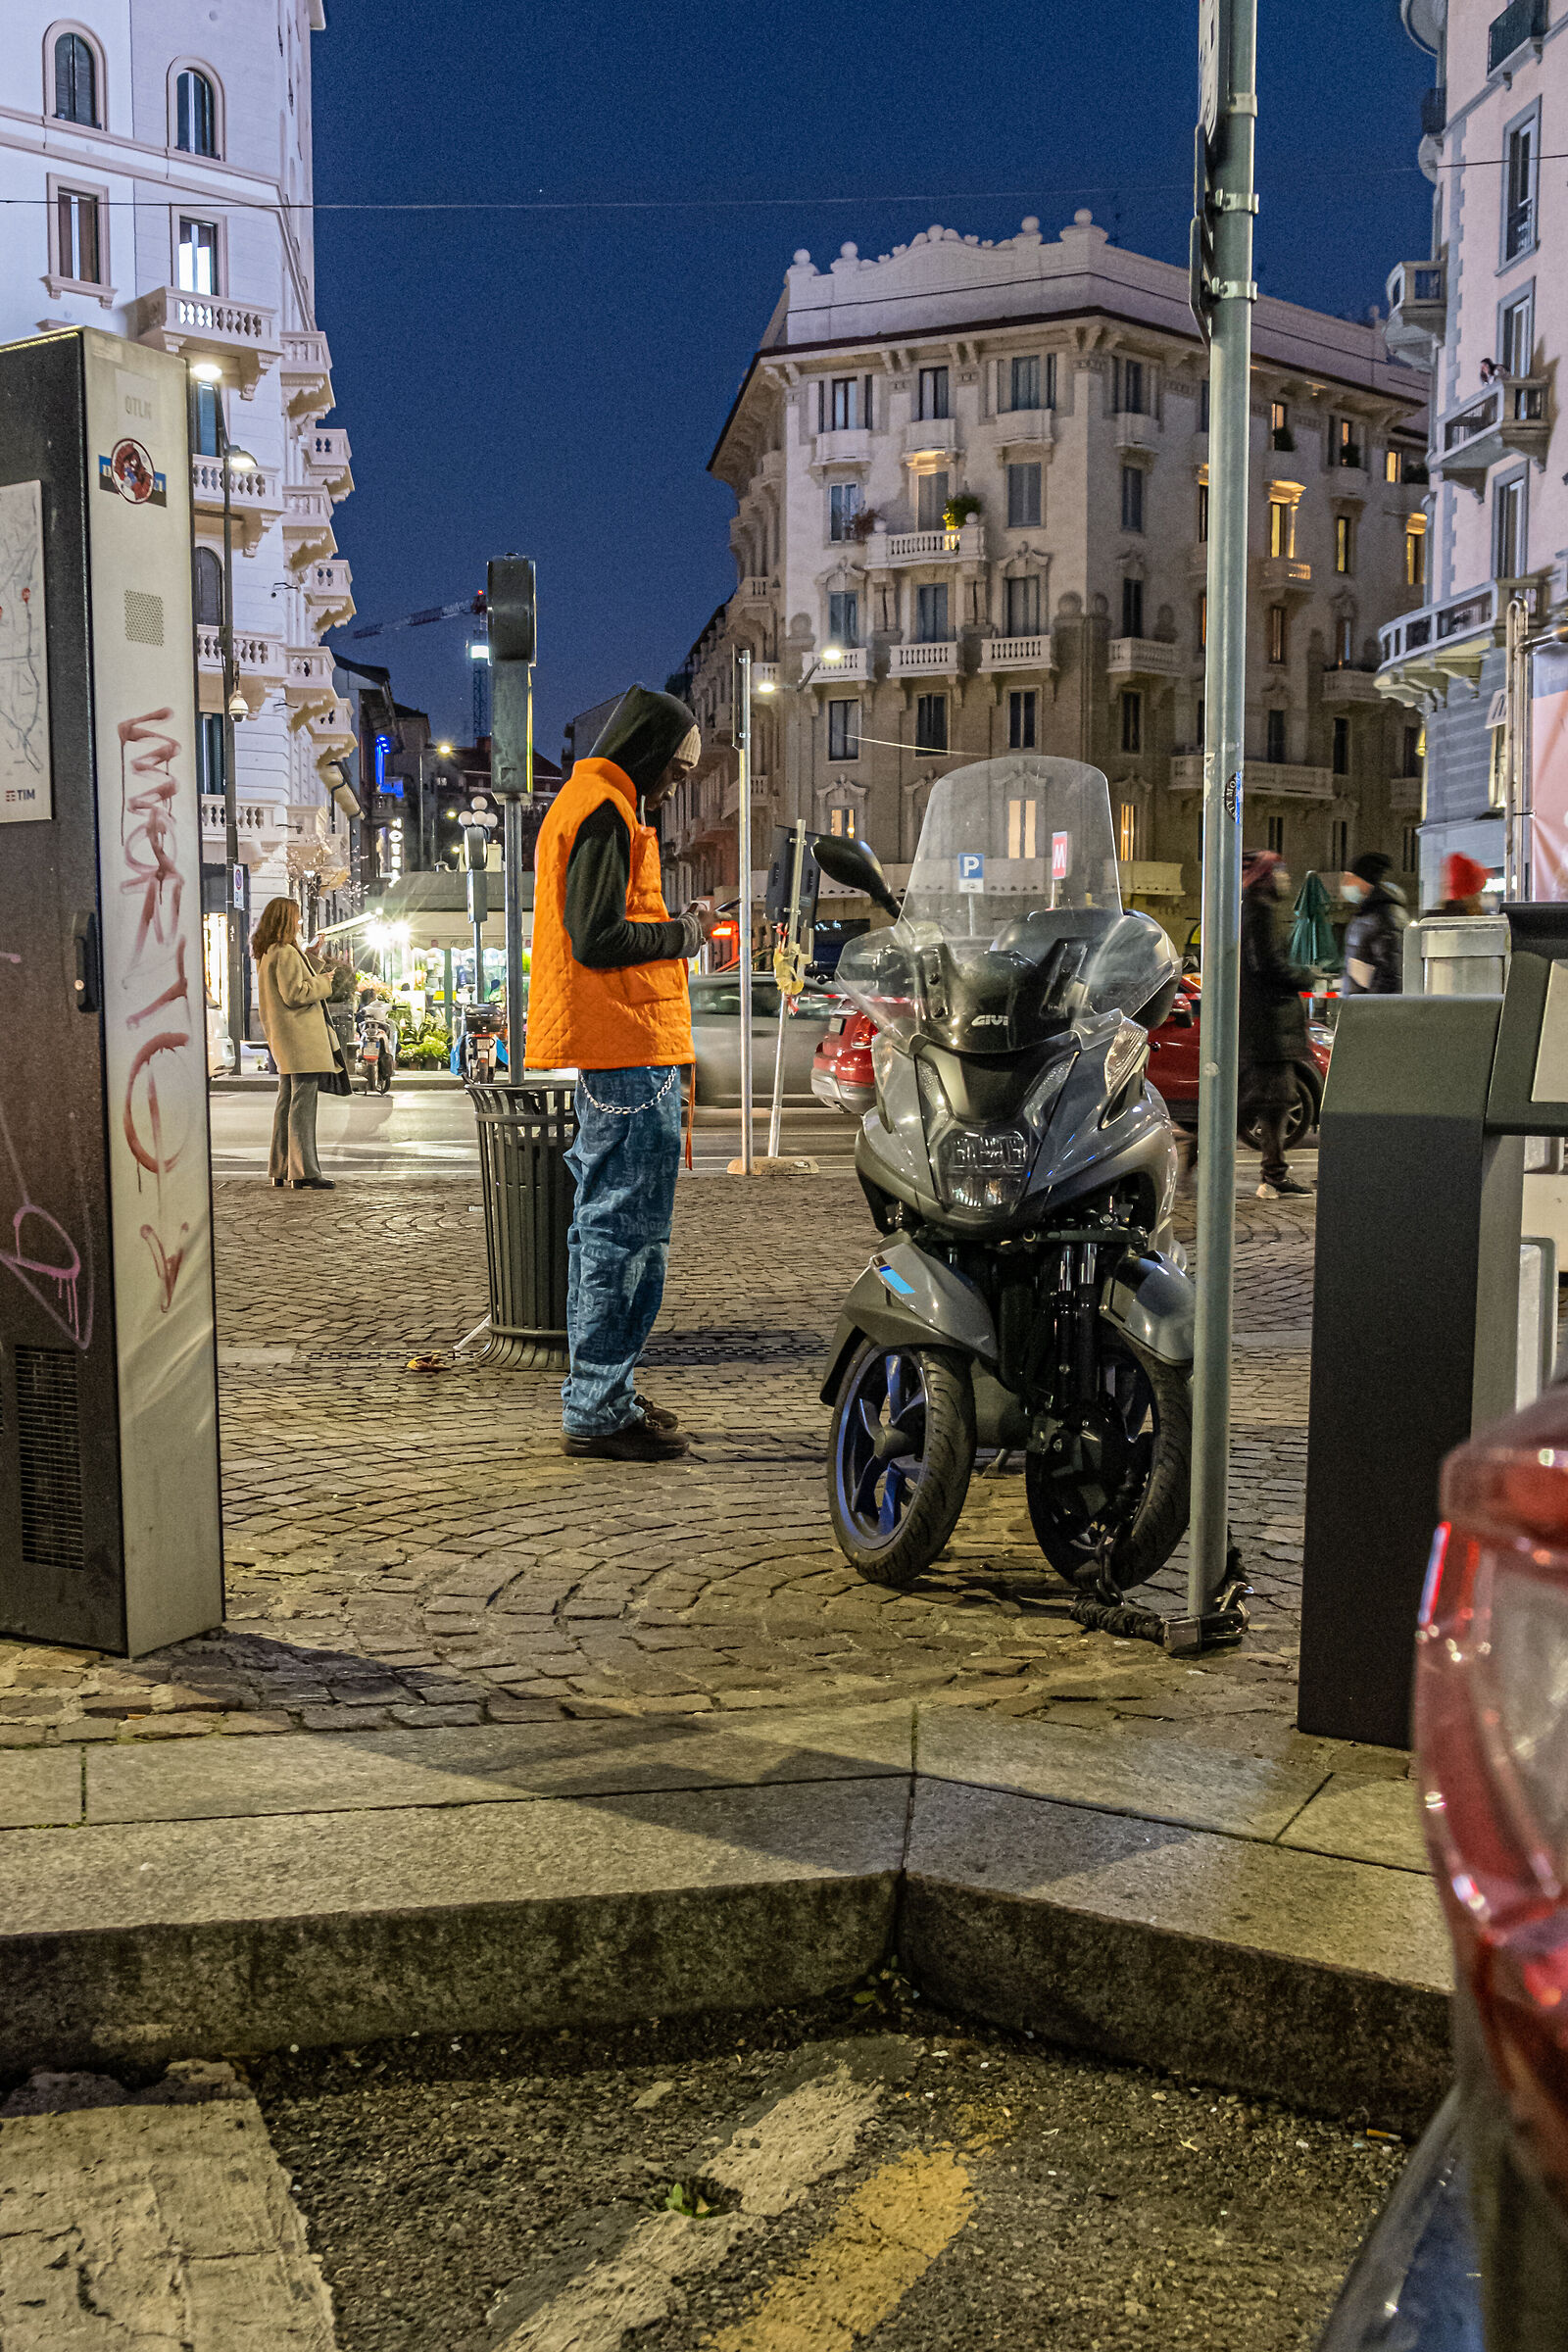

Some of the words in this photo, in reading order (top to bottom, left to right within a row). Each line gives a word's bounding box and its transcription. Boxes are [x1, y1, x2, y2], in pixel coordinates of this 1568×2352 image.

[17, 789, 35, 801] TIM
[1054, 843, 1066, 869] M
[963, 856, 980, 877] P
[971, 1014, 1009, 1026] GIVI
